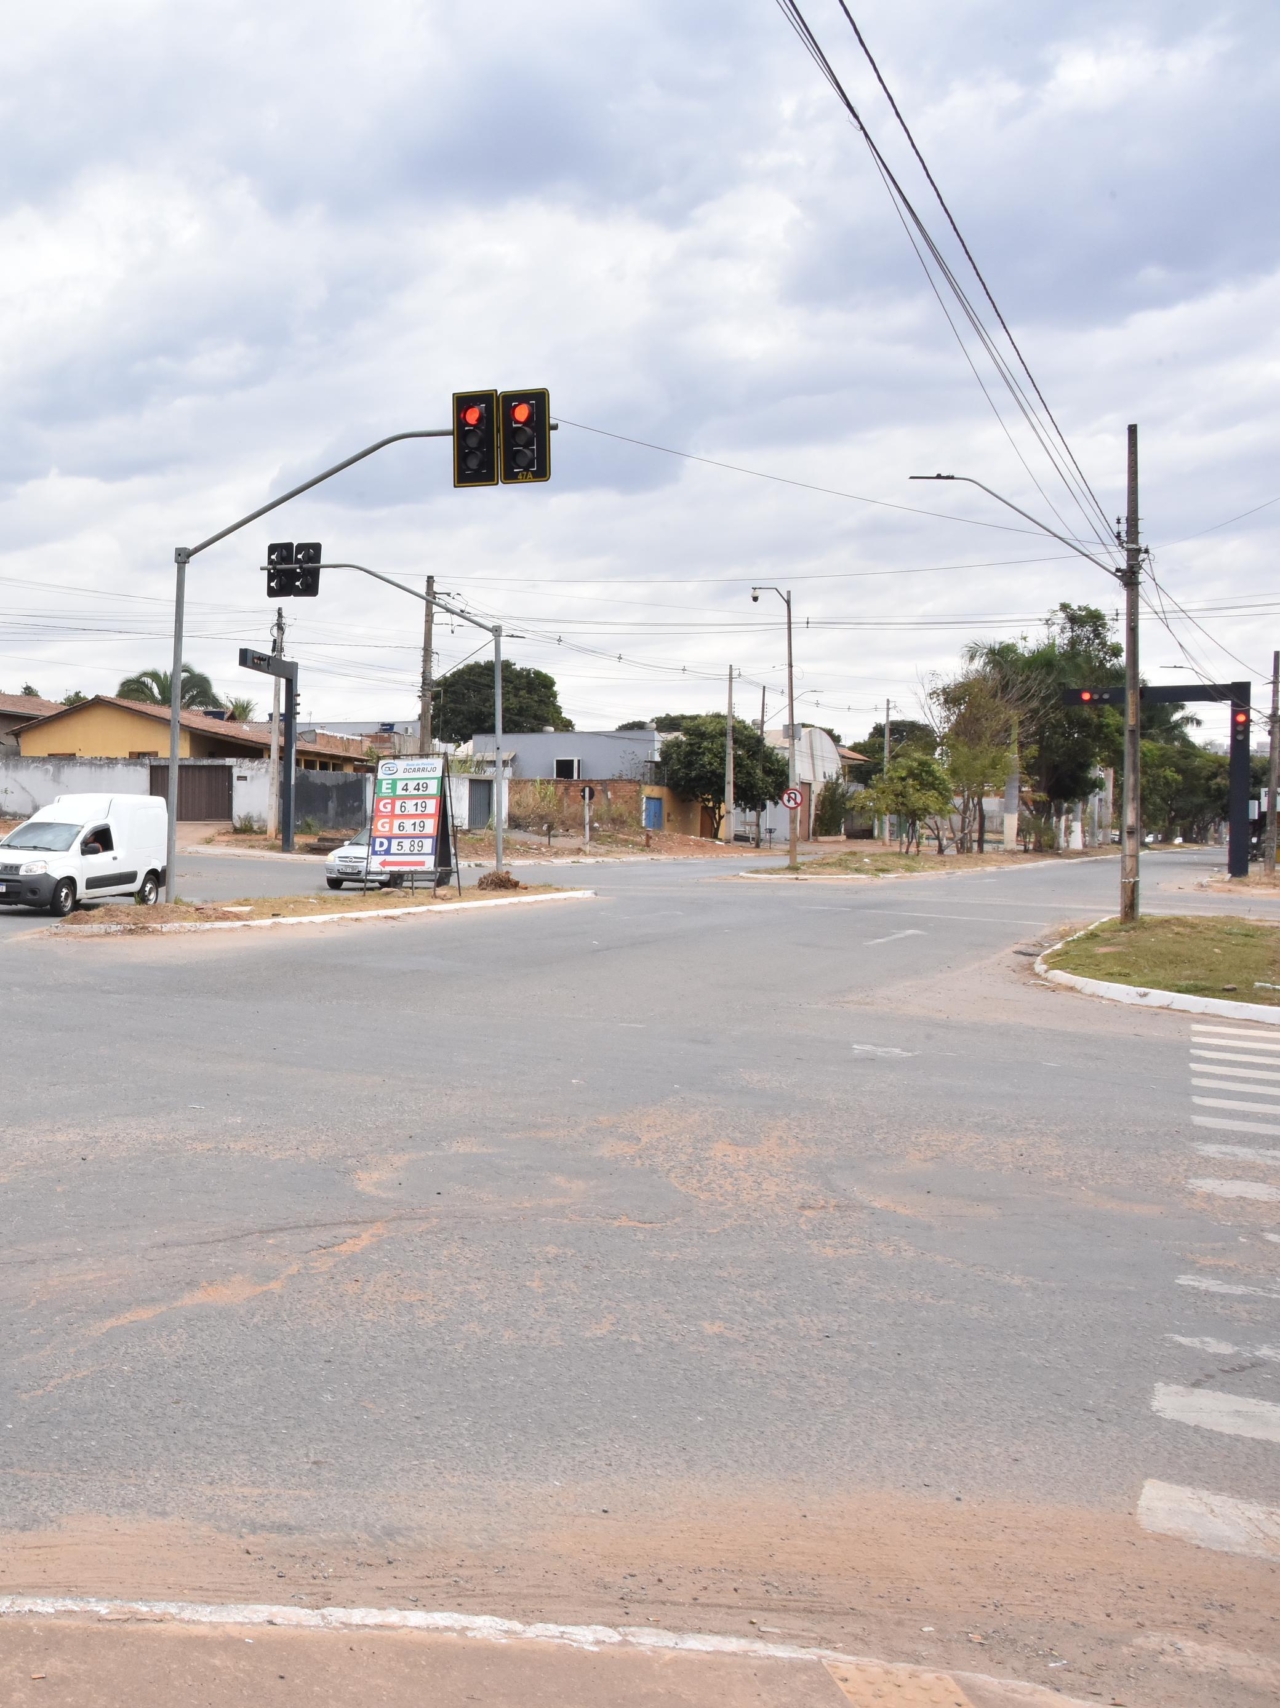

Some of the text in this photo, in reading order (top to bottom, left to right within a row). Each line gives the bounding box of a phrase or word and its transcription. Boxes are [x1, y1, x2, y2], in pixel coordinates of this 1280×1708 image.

[517, 472, 533, 480] 47A
[402, 766, 437, 774] DCARRIJO
[381, 780, 429, 793] E 4,49
[379, 799, 427, 813] G 6,19
[377, 818, 426, 832] G 6,19
[374, 838, 424, 852] D 5,89
